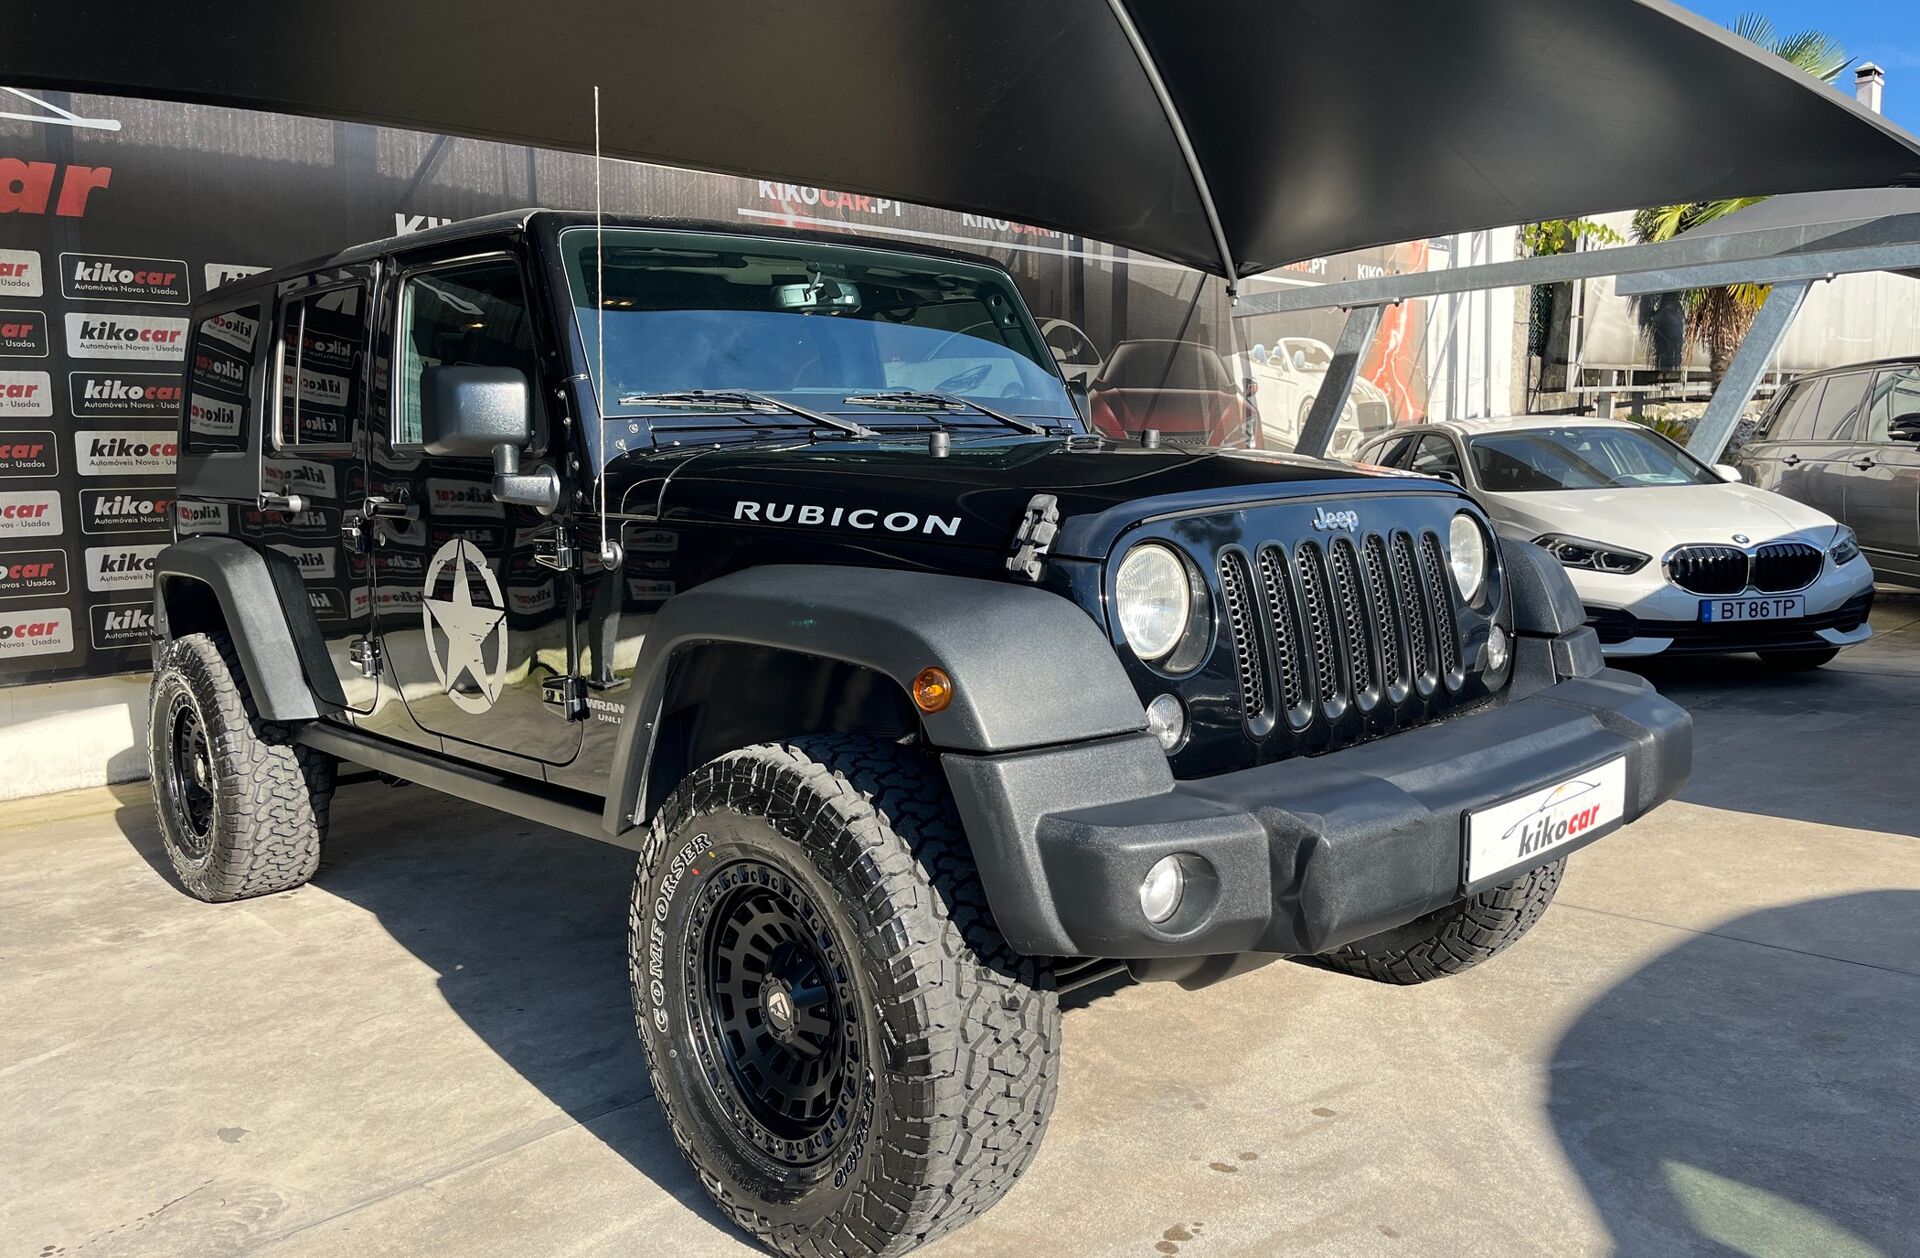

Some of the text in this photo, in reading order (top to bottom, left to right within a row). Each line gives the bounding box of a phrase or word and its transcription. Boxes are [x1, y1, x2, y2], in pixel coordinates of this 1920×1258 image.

[75, 262, 176, 286] kikocar
[75, 283, 118, 292] Automóveis
[121, 286, 144, 294] Novos
[151, 287, 178, 296] Usados
[80, 321, 181, 343] kikocar
[126, 344, 149, 352] Novos
[156, 345, 183, 353] Usados
[84, 401, 128, 409] Automóveis
[734, 501, 961, 536] RUBICON
[1311, 506, 1359, 532] Jeep
[1517, 803, 1601, 858] kikocar
